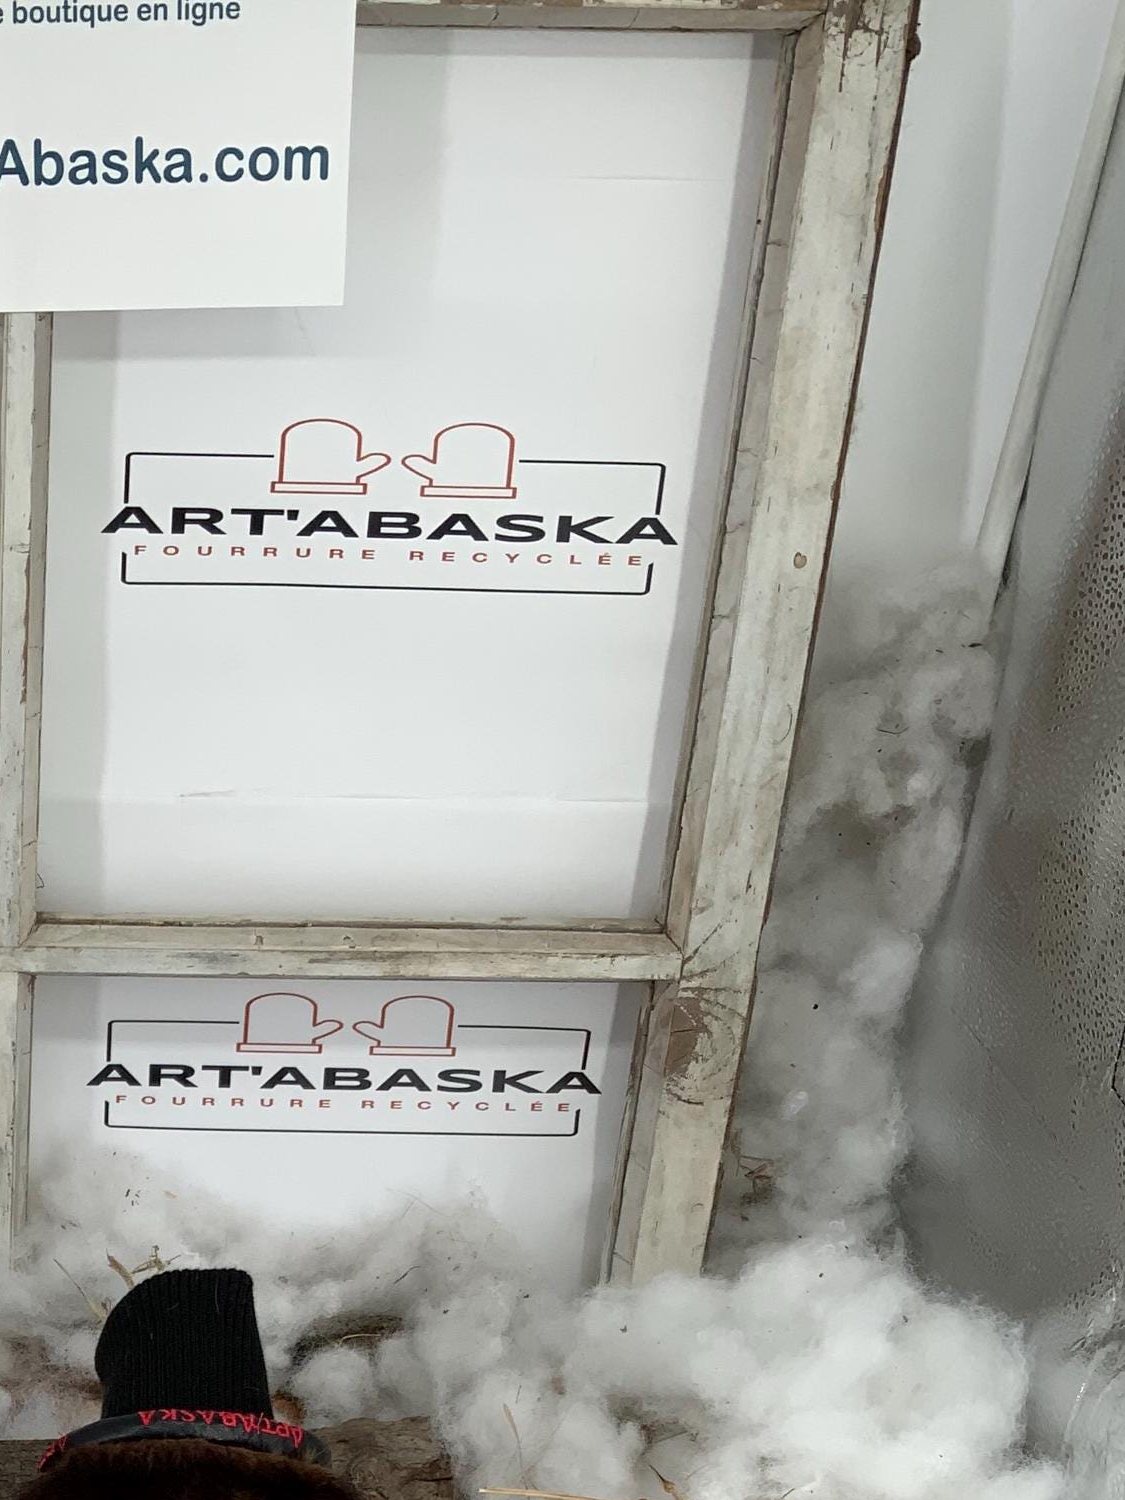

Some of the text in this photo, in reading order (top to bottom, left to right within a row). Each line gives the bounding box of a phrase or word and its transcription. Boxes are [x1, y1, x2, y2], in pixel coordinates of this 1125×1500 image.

[12, 0, 129, 28] boutique
[136, 3, 168, 21] en
[176, 0, 241, 27] ligne
[101, 505, 678, 546] ART'ABASKA
[133, 544, 642, 567] FOURRURE RECYCLÉE
[86, 1064, 602, 1095] ART'ABASKA
[116, 1095, 571, 1113] FOURRURE RECYCLÉE
